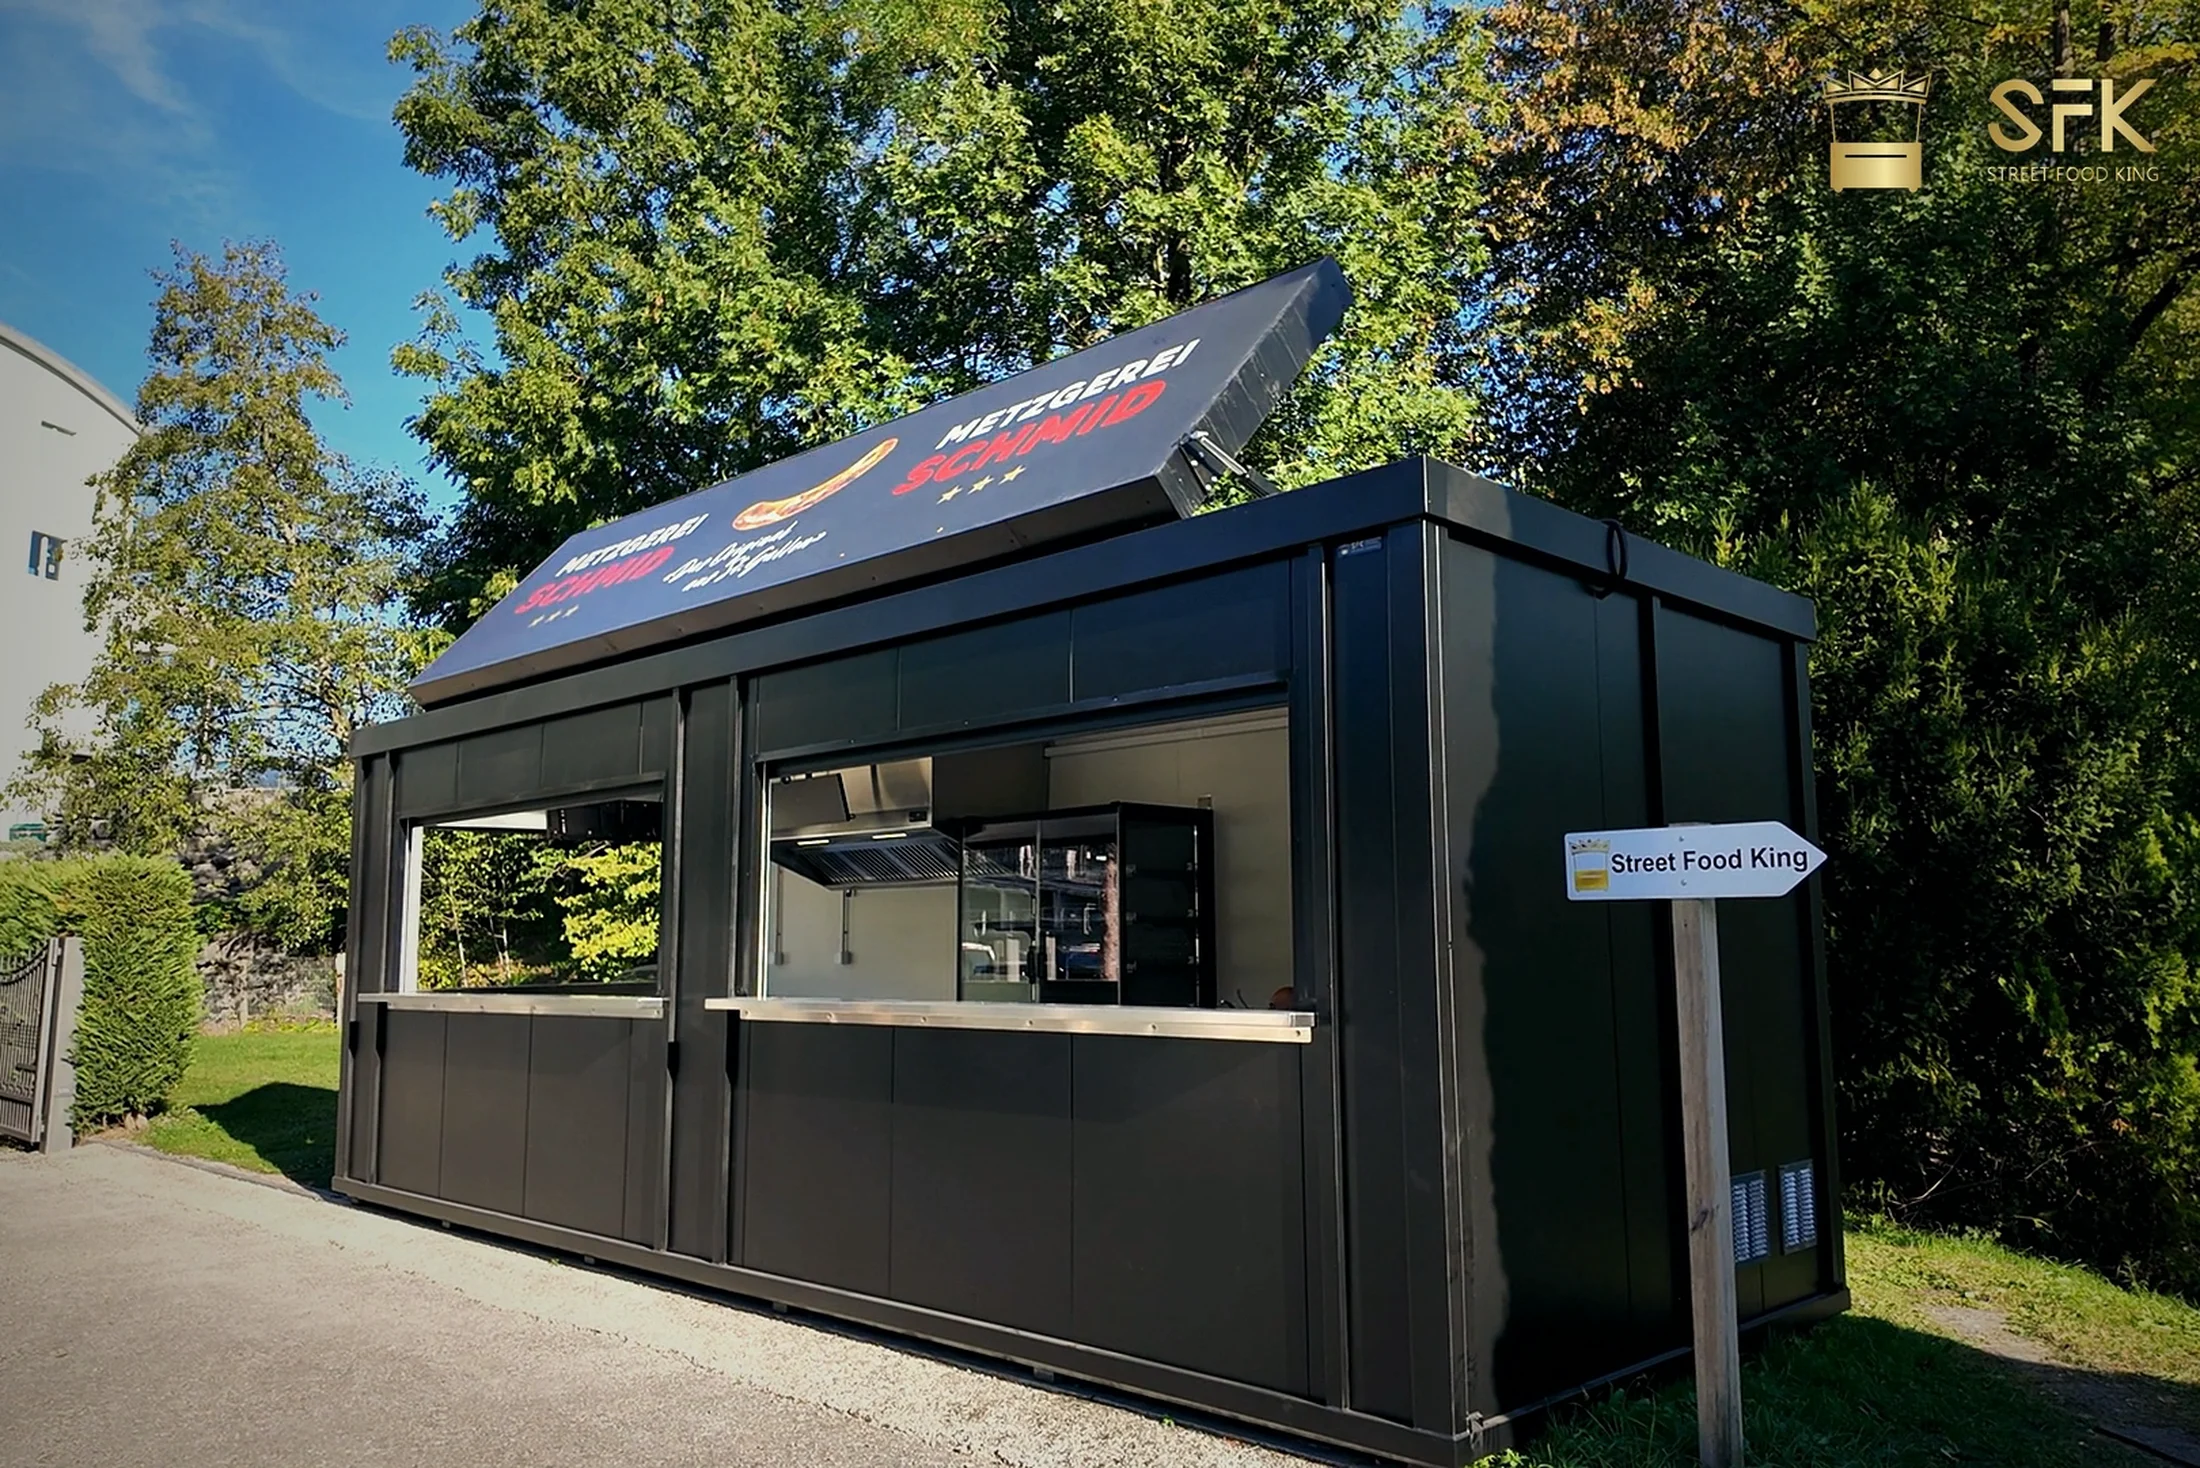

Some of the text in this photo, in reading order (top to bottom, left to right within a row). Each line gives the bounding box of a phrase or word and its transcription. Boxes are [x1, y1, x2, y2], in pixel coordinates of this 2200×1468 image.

[934, 338, 1200, 450] METZGEREI
[891, 379, 1167, 496] SCHMID
[555, 513, 710, 577] METZGEREI
[709, 520, 798, 567] Original
[514, 545, 675, 615] SCHMID
[1611, 847, 1809, 874] Street Food King
